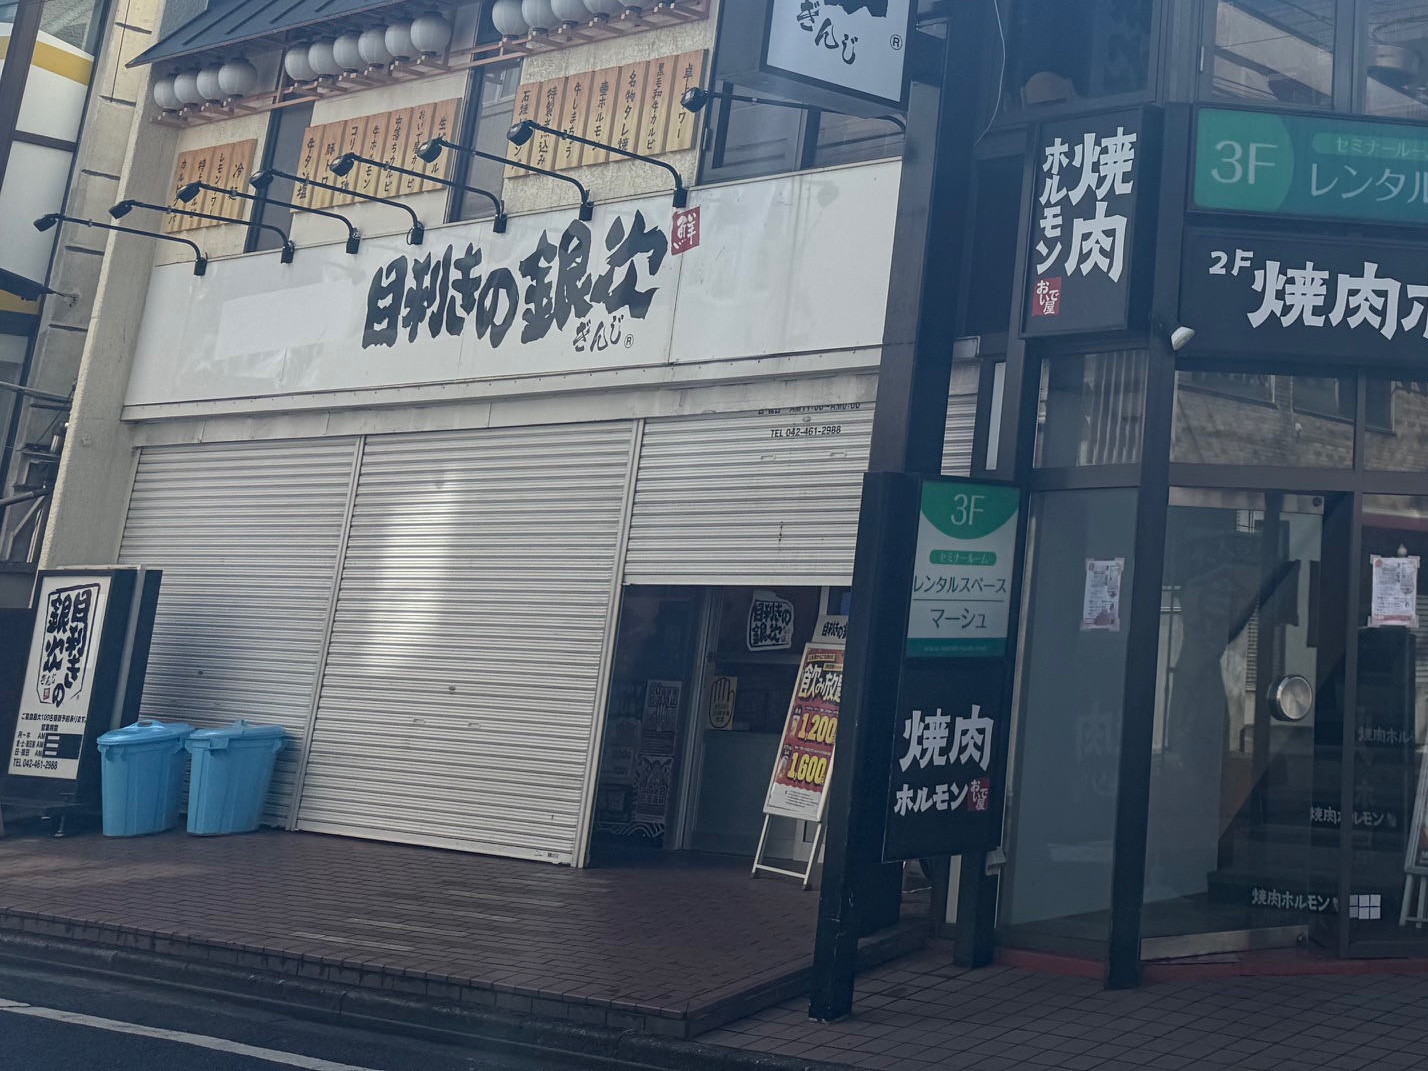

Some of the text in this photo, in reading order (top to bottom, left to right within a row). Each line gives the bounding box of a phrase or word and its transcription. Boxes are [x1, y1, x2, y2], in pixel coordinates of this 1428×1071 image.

[796, 0, 858, 65] ぎんじ
[677, 62, 694, 139] 卓上ワー
[431, 115, 447, 175] 生ビル
[1210, 140, 1279, 185] 3F
[1036, 137, 1070, 275] ホルモン
[1064, 126, 1137, 283] 焼肉
[673, 213, 696, 250] 鮮
[362, 209, 668, 349] 目利きの銀次
[1208, 247, 1254, 276] 2F
[1036, 280, 1060, 315] おいで屋
[573, 315, 625, 352] ぎんじ
[770, 426, 841, 438] TEL 042-461-2988
[950, 493, 986, 527] 3F
[913, 575, 1006, 593] レンタルスペース
[930, 608, 987, 629] マーシュ
[899, 704, 995, 772] 焼肉
[13, 758, 21, 767] TEL
[893, 781, 969, 817] ホルモン
[1252, 888, 1330, 911] 焼肉ホルモン
